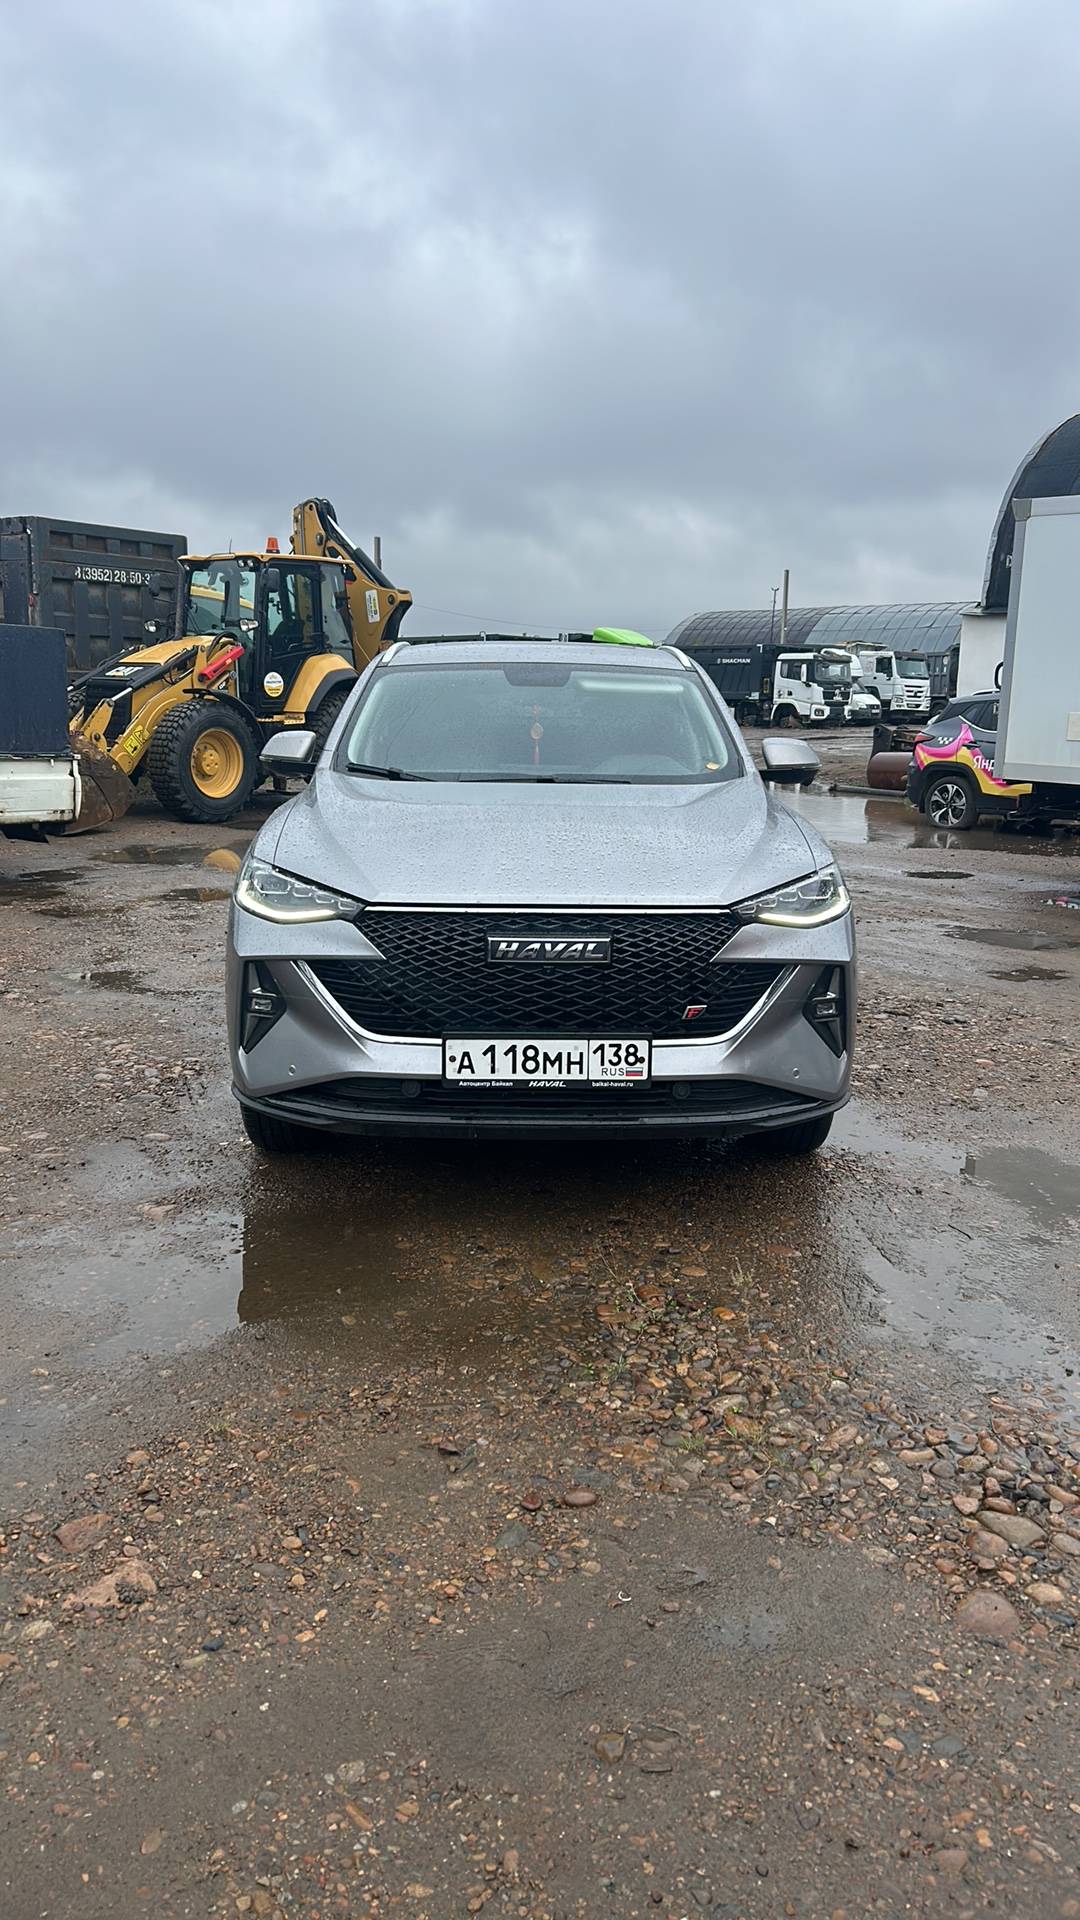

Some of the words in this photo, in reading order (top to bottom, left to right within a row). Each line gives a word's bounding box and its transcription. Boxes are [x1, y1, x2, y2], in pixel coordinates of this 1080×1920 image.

[105, 666, 144, 676] CAT
[495, 942, 604, 958] HAVAL
[592, 1043, 639, 1067] 138
[601, 1067, 625, 1076] RUS
[458, 1080, 491, 1088] Автоцентр
